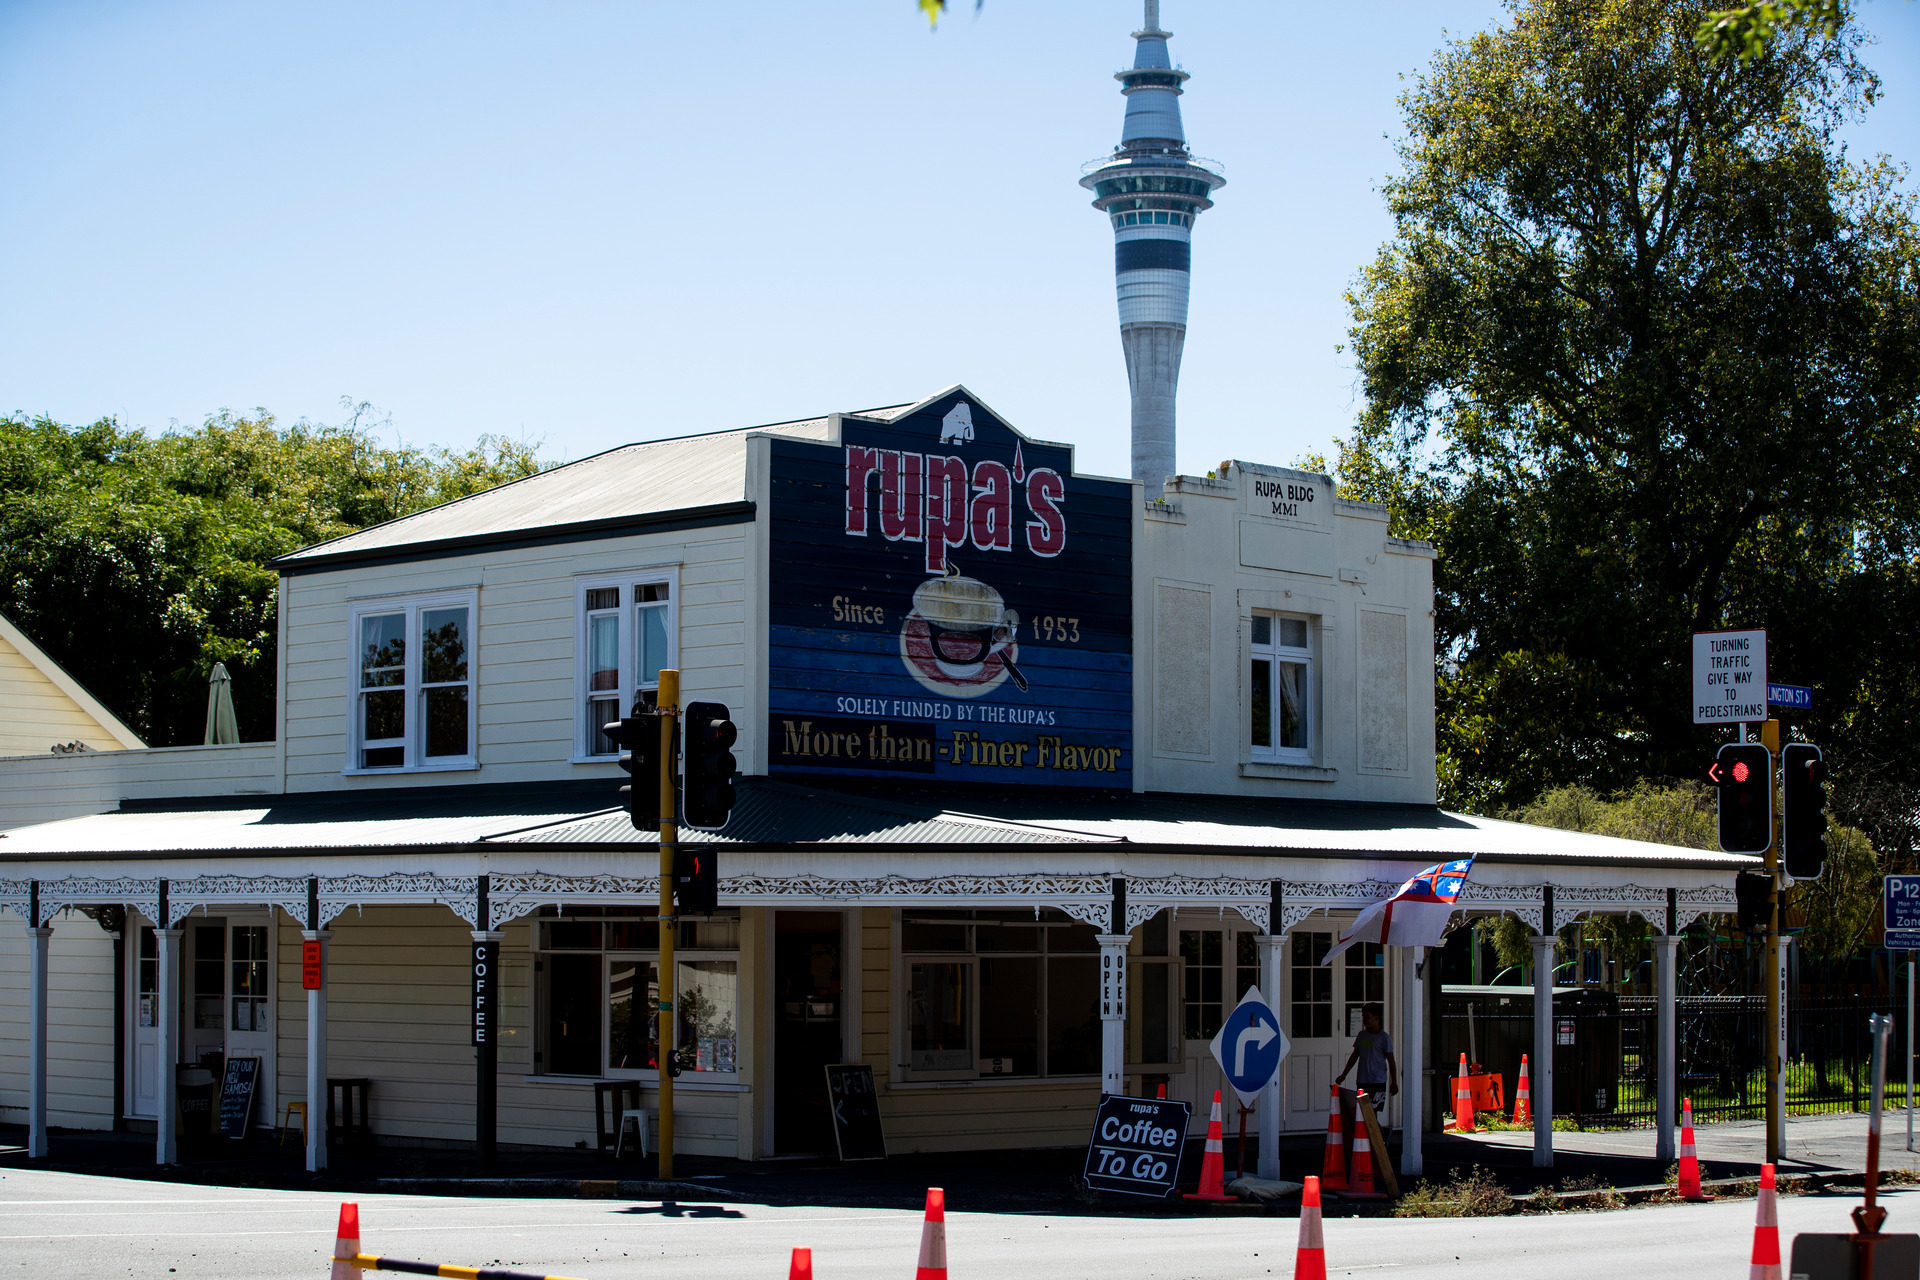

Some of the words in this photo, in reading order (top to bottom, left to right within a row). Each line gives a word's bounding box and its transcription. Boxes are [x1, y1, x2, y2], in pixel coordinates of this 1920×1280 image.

[1256, 480, 1283, 498] RUPA
[1288, 484, 1314, 502] BLDG
[845, 438, 1066, 575] rupa's
[1272, 502, 1298, 516] MMI
[832, 594, 885, 626] Since
[1032, 616, 1081, 643] 1953
[1710, 638, 1750, 652] TURNING
[1710, 656, 1750, 668] TRAFFIC
[1708, 672, 1729, 685] GIVE
[1734, 671, 1752, 684] WAY
[1725, 688, 1737, 701] TO
[1796, 690, 1804, 704] ST
[836, 696, 888, 716] SOLELY
[893, 700, 952, 720] FUNDED
[956, 704, 974, 721] BY
[978, 706, 1006, 724] THE
[1009, 709, 1056, 726] RUPA'S
[1698, 703, 1764, 718] PEDESTRIANS
[782, 720, 862, 758] More
[869, 724, 932, 763] than
[1036, 734, 1122, 774] Flavor
[475, 946, 487, 1042] COFFEE
[228, 1060, 240, 1072] TRY
[241, 1061, 254, 1072] OUR
[226, 1072, 240, 1084] NEW
[830, 1069, 874, 1095] OPEN
[224, 1082, 252, 1095] SAMOSA
[181, 1098, 210, 1112] COFFEE
[1130, 1102, 1160, 1116] rupa's
[1101, 1116, 1178, 1148] Coffee
[1097, 1149, 1126, 1176] To
[1132, 1153, 1168, 1181] Go
